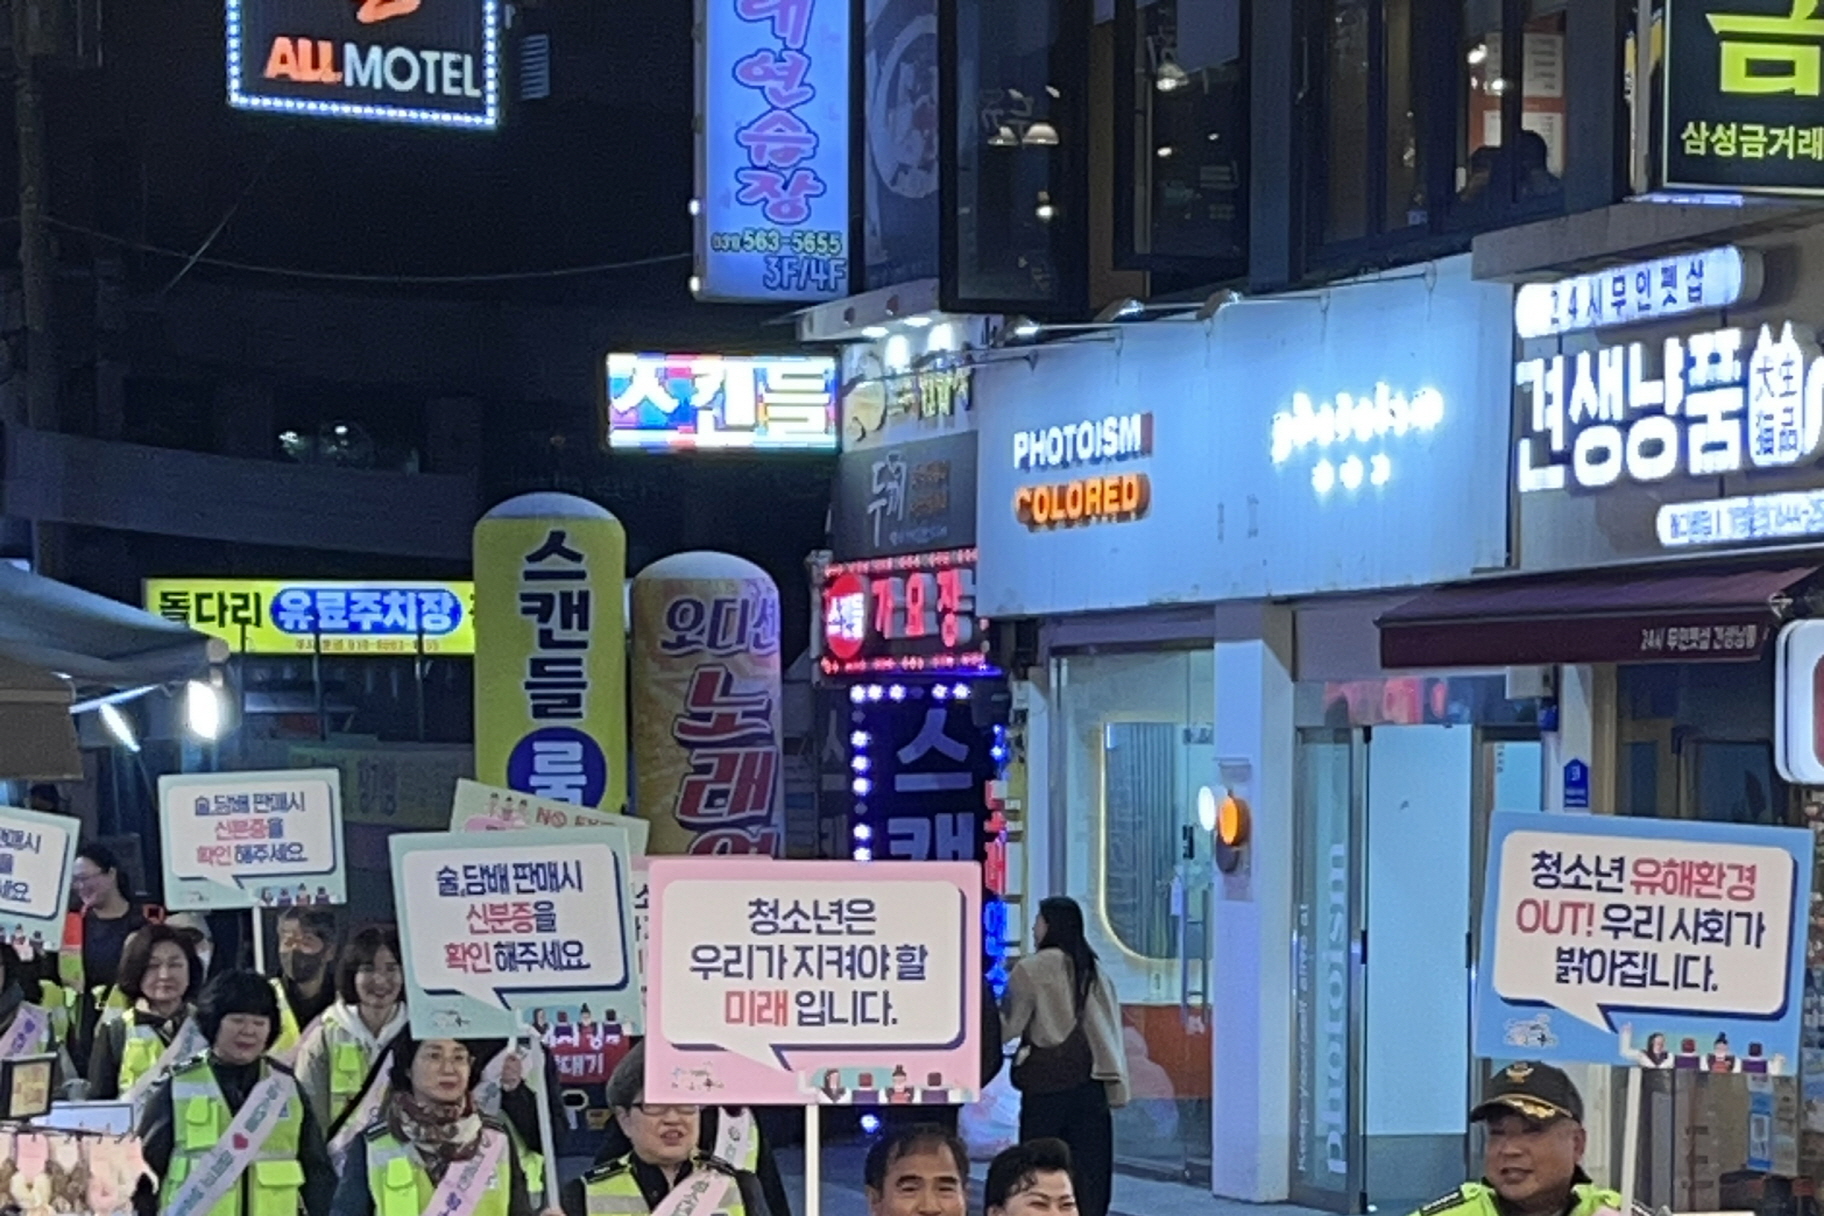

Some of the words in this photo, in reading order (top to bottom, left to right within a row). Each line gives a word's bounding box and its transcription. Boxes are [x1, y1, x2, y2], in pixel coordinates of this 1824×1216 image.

[754, 255, 847, 291] 3F/4F
[1013, 413, 1143, 470] PHOTOISM
[1014, 474, 1141, 524] COLORED
[520, 530, 591, 720] 스캔들
[512, 860, 583, 894] 판매시
[1531, 850, 1625, 893] 청소년
[1630, 857, 1758, 901] 유해환경
[466, 900, 557, 935] 신분증을
[748, 898, 877, 936] 청소년은
[1516, 898, 1595, 937] OUT!
[1600, 903, 1664, 943] 우리
[1669, 906, 1767, 949] 사회가
[444, 942, 492, 973] 확인
[689, 944, 788, 981] 우리가
[792, 944, 891, 981] 지켜야
[895, 944, 929, 981] 할
[1555, 946, 1718, 992] 밝아집니다.
[725, 989, 789, 1027] 미래
[795, 989, 898, 1027] 입니다.
